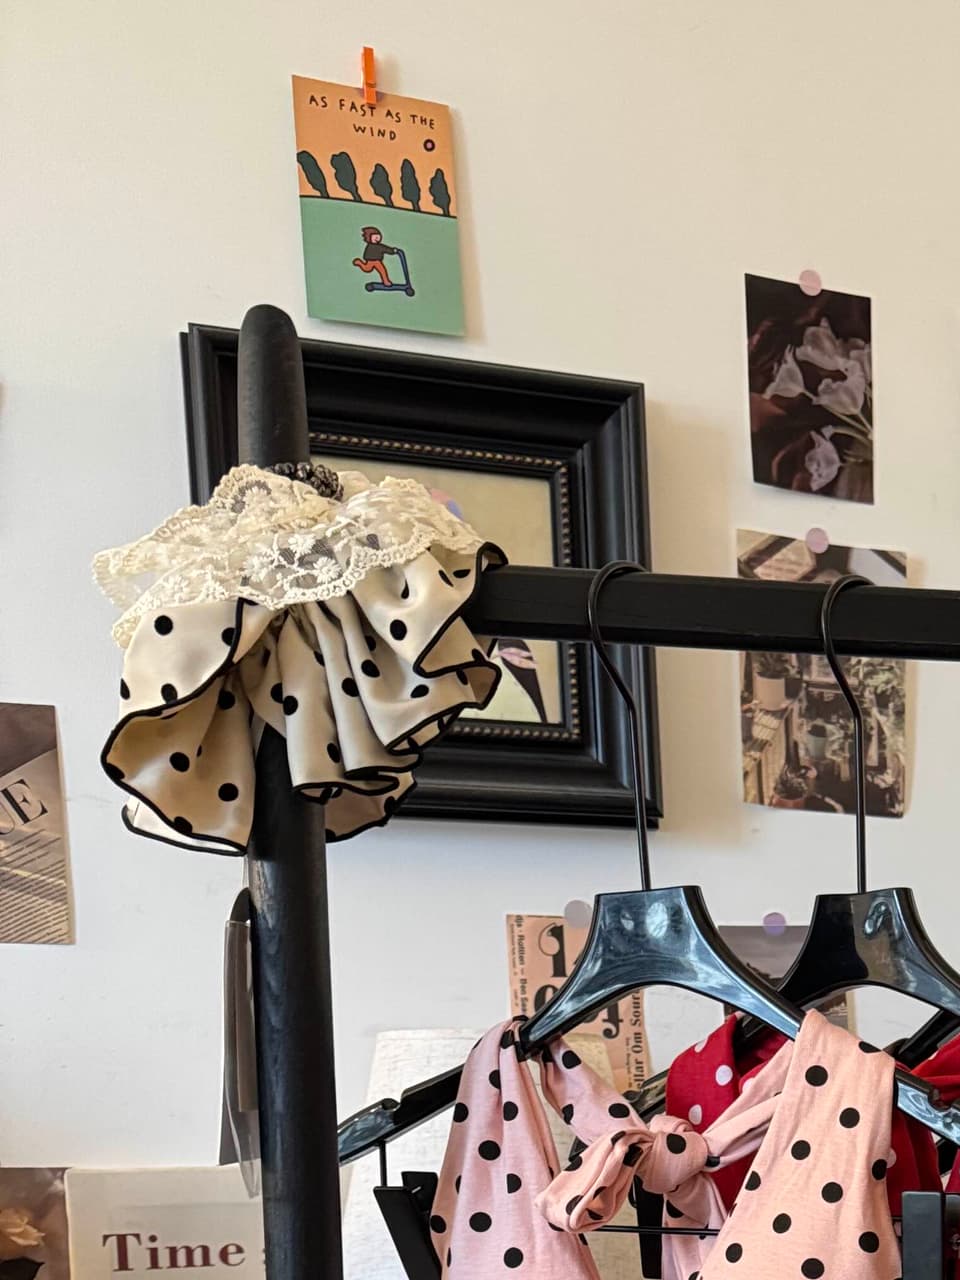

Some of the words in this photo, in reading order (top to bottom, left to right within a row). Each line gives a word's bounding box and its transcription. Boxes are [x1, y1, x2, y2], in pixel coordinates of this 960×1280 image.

[309, 95, 328, 108] AS
[338, 99, 376, 118] FAST
[385, 109, 401, 123] AS
[409, 114, 435, 130] THE
[353, 123, 397, 141] WIND
[102, 1233, 246, 1272] Time
